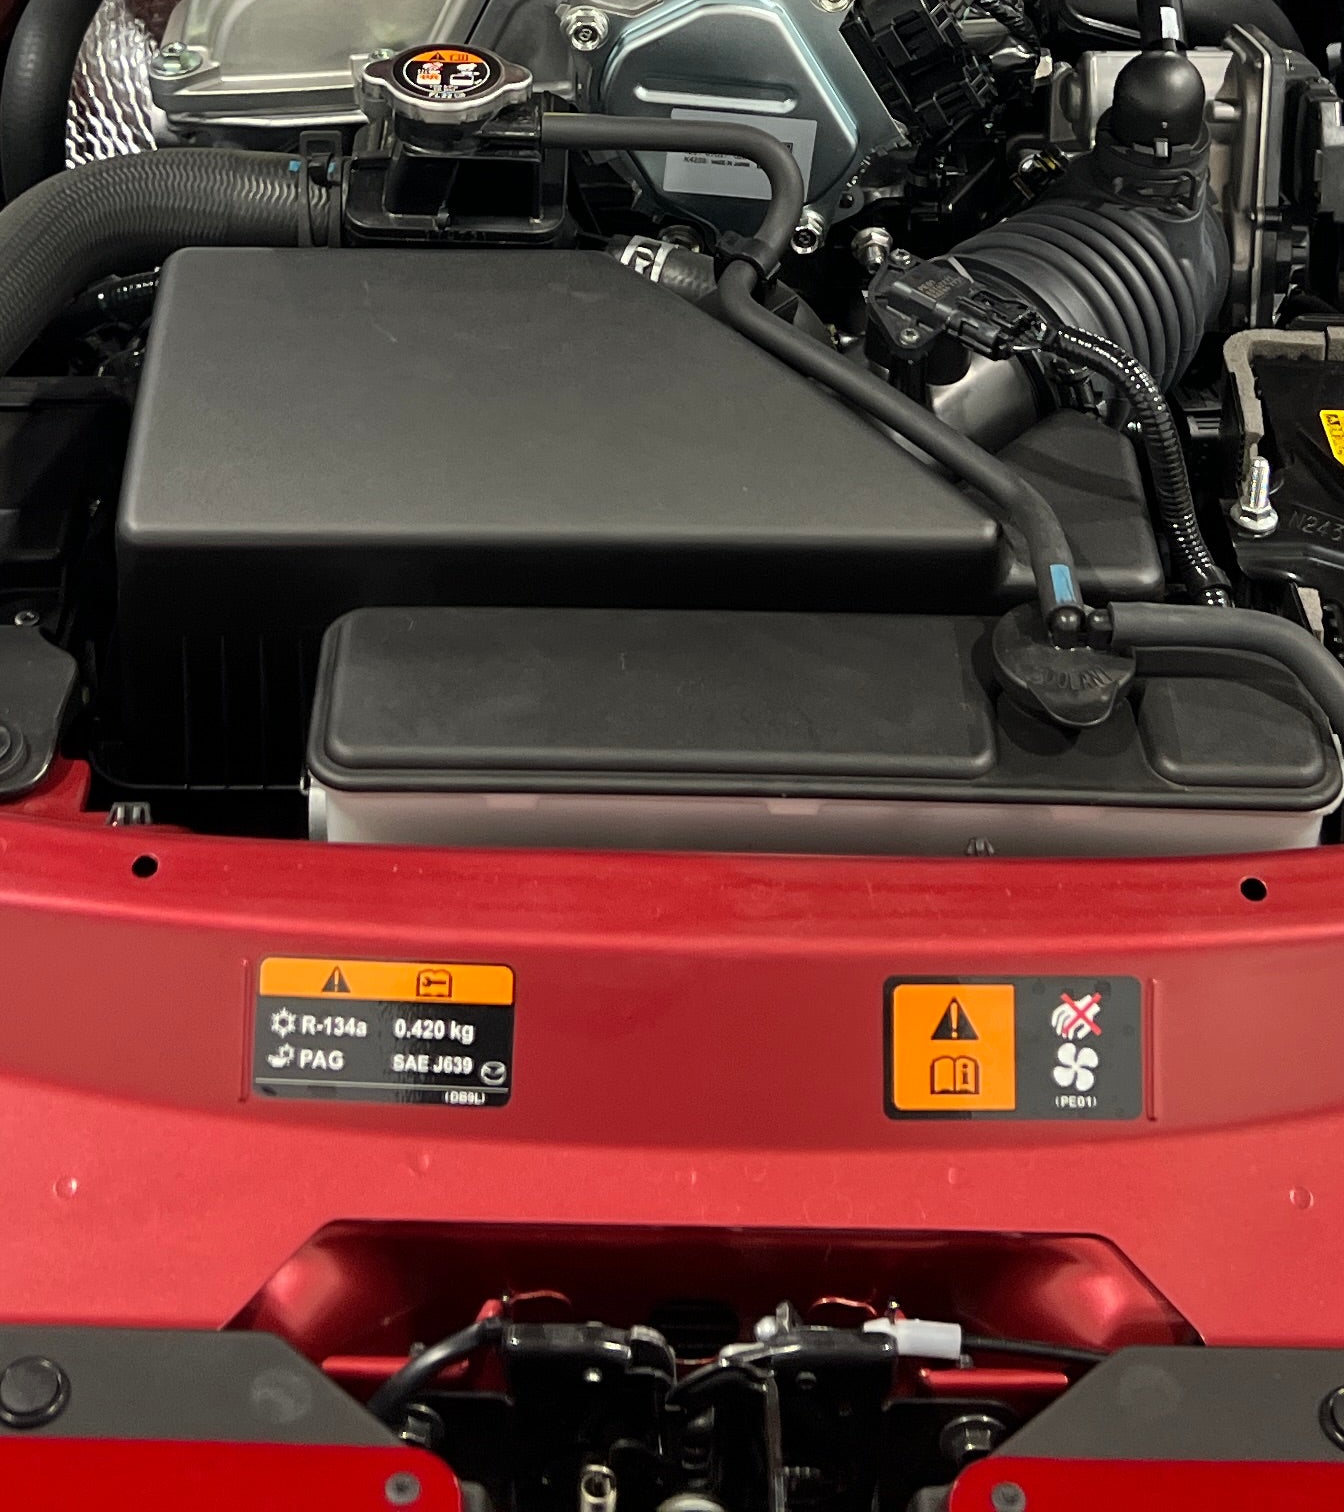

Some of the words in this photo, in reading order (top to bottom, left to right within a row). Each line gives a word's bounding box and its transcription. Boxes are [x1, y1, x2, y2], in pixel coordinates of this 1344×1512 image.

[301, 1015, 368, 1038] R-134a
[393, 1018, 446, 1040] 0.420
[449, 1020, 475, 1045] kg
[299, 1049, 345, 1071] PAG
[391, 1054, 430, 1073] SAE
[433, 1056, 474, 1075] J639
